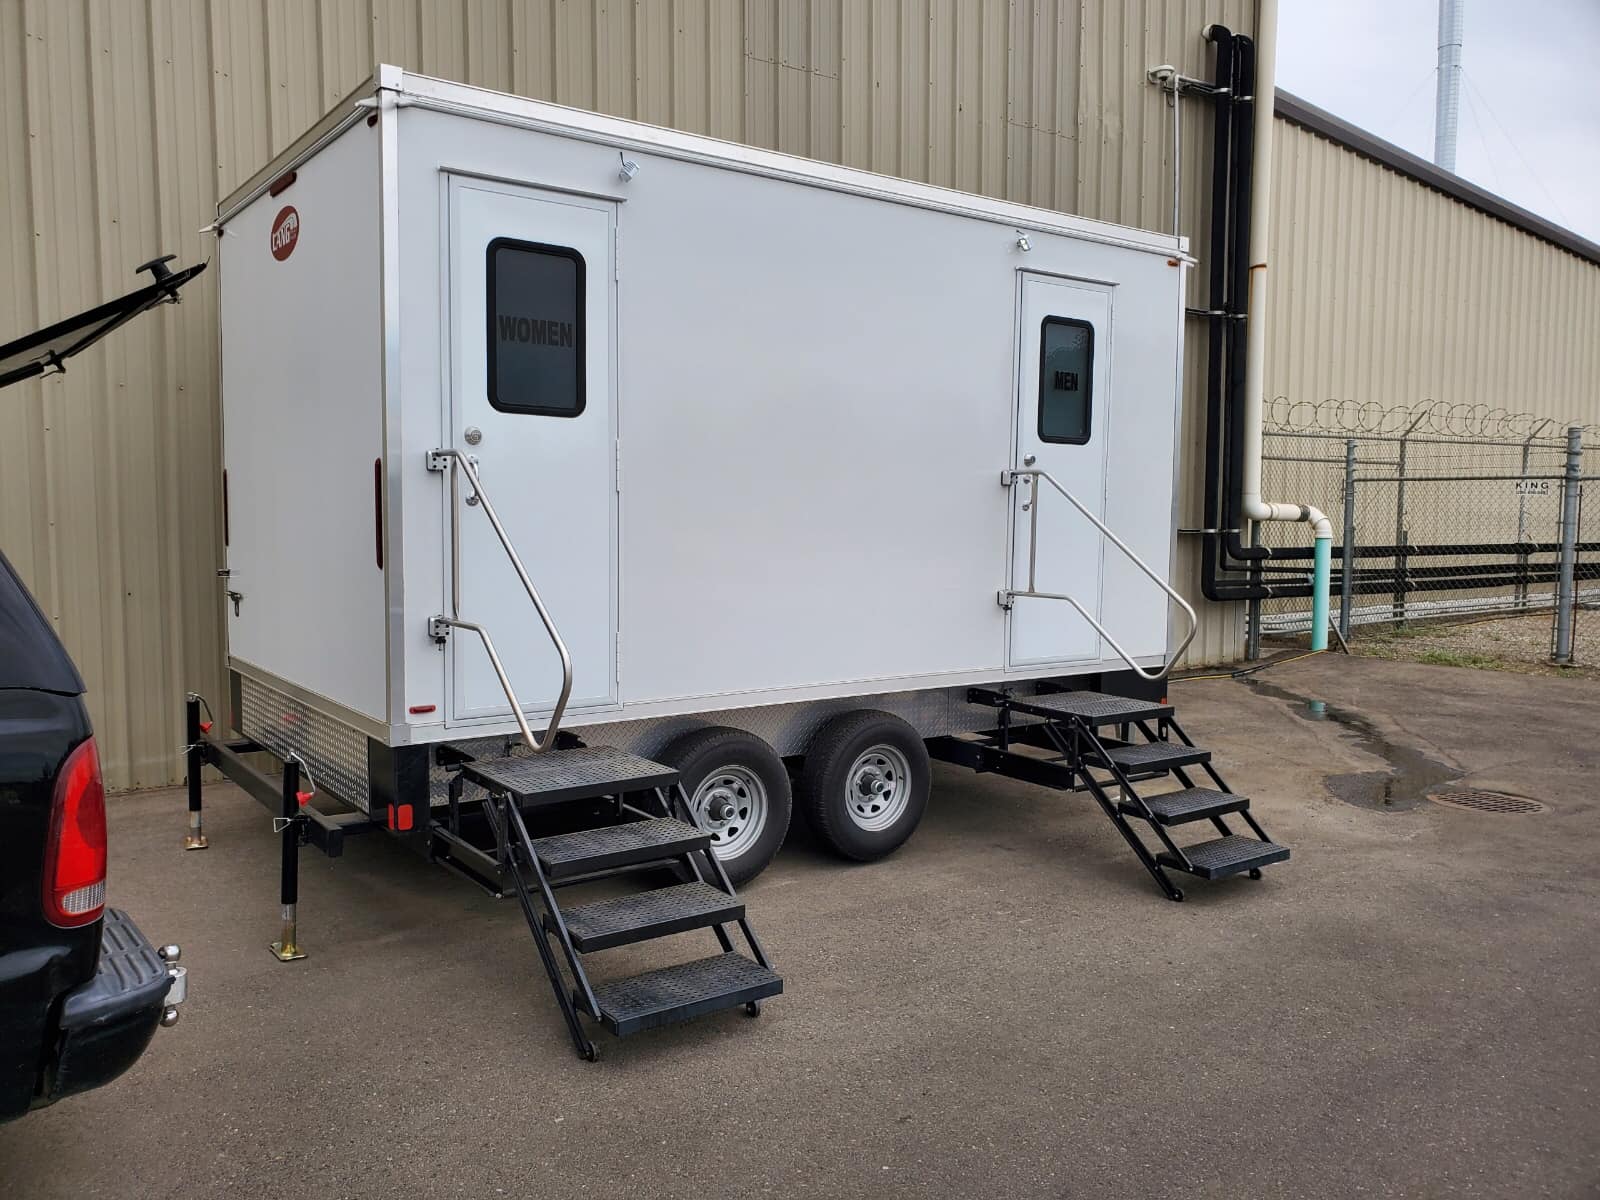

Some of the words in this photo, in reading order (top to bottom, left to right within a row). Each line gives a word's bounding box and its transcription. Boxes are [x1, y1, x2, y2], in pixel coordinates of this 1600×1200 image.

[499, 315, 573, 348] WOMEN
[1055, 371, 1079, 391] MEN
[1515, 482, 1549, 490] KING
